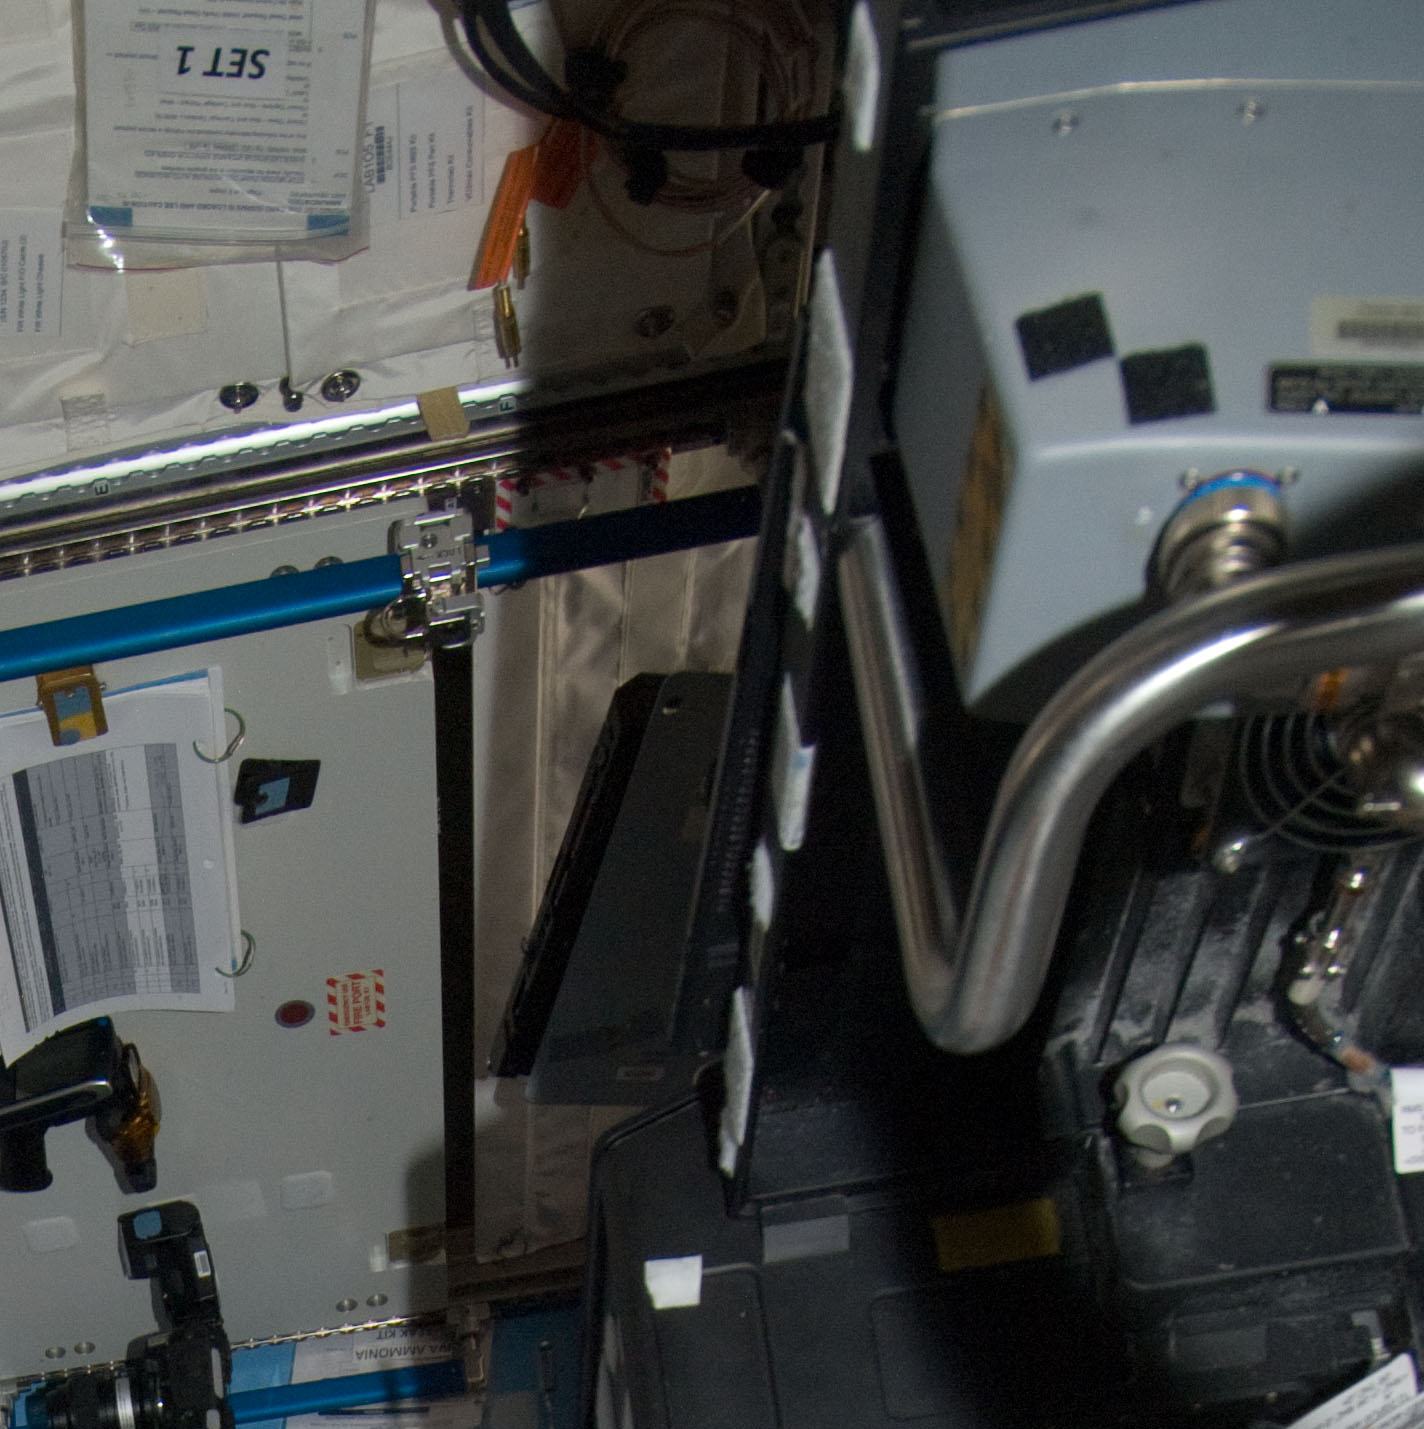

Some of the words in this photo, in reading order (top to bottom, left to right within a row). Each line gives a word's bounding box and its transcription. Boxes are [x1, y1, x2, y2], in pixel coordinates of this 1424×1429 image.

[176, 46, 194, 75] 1
[203, 47, 270, 80] SET
[354, 1344, 426, 1361] AMMONIA
